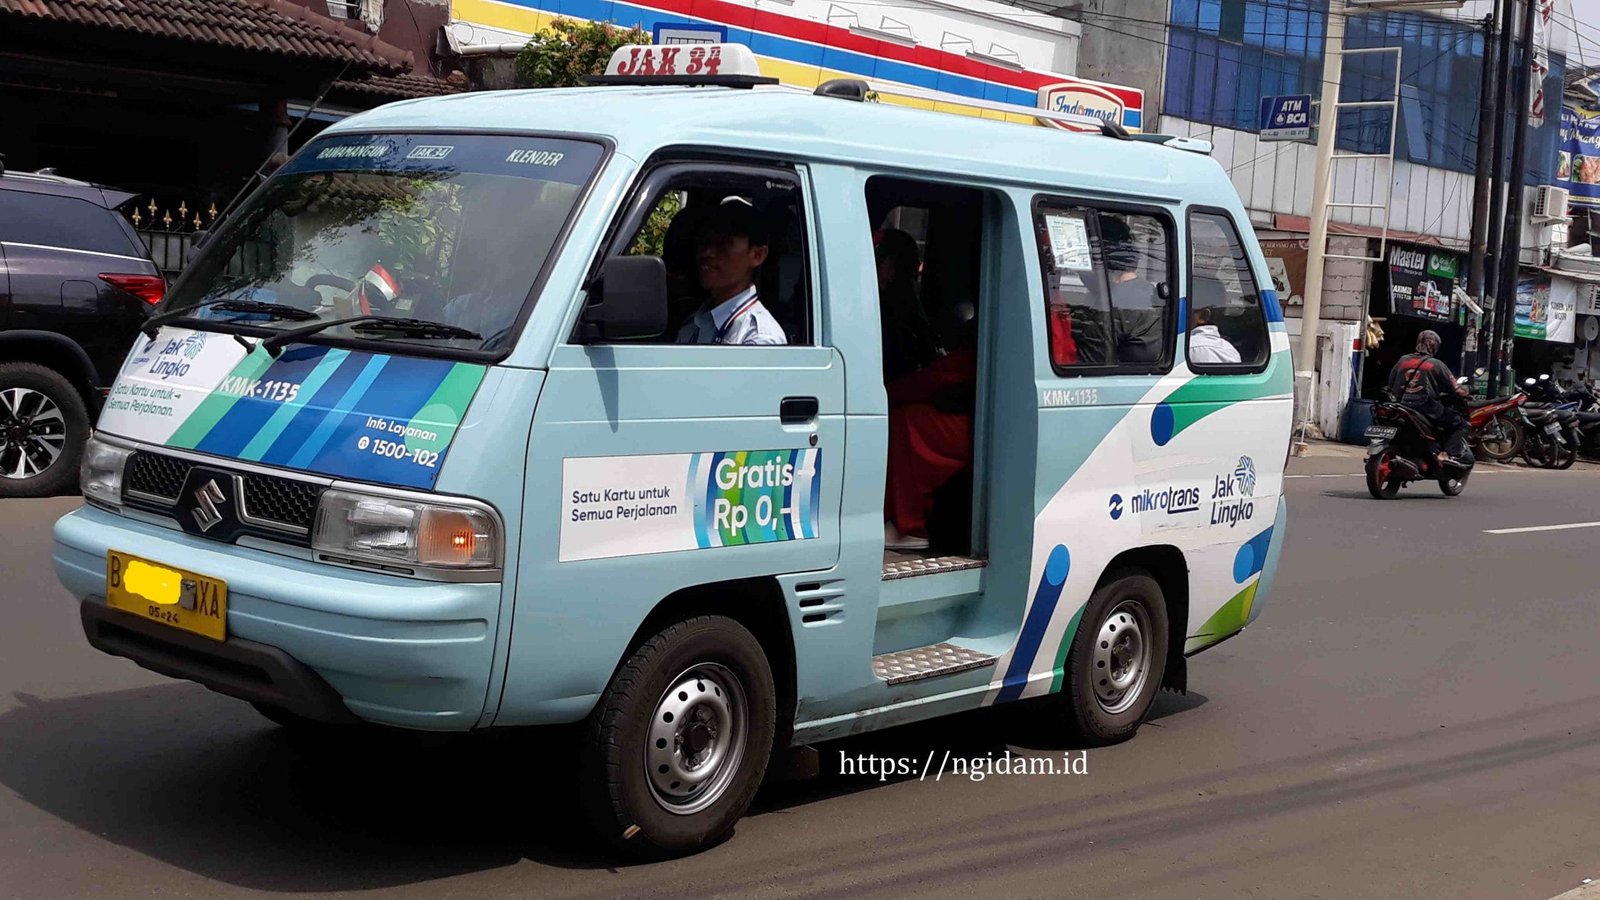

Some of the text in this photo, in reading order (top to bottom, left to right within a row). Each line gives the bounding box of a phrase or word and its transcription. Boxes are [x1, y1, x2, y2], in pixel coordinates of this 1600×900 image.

[617, 46, 722, 75] JAK 34
[1053, 95, 1117, 121] Indomaret
[1281, 100, 1303, 112] ATM
[1286, 113, 1307, 124] BCA
[317, 145, 389, 160] RAWAMANGUN
[412, 147, 435, 157] JAK
[506, 148, 564, 167] KLENDER
[159, 338, 184, 355] Jak
[149, 356, 191, 380] Lingko
[114, 382, 173, 400] Satu Kartu untuk
[108, 398, 173, 416] Semua Perjalanan.
[366, 416, 437, 442] Info Layanan
[372, 439, 439, 468] 1500-102
[715, 456, 793, 490] Gratis
[1211, 473, 1235, 499] Jak
[572, 486, 671, 504] Satu Kartu untuk
[1131, 486, 1200, 514] mikrotrans
[571, 503, 677, 522] Semua Perjalanan
[713, 497, 748, 537] Rp
[1210, 498, 1253, 528] Lingko
[111, 556, 220, 619] B XA
